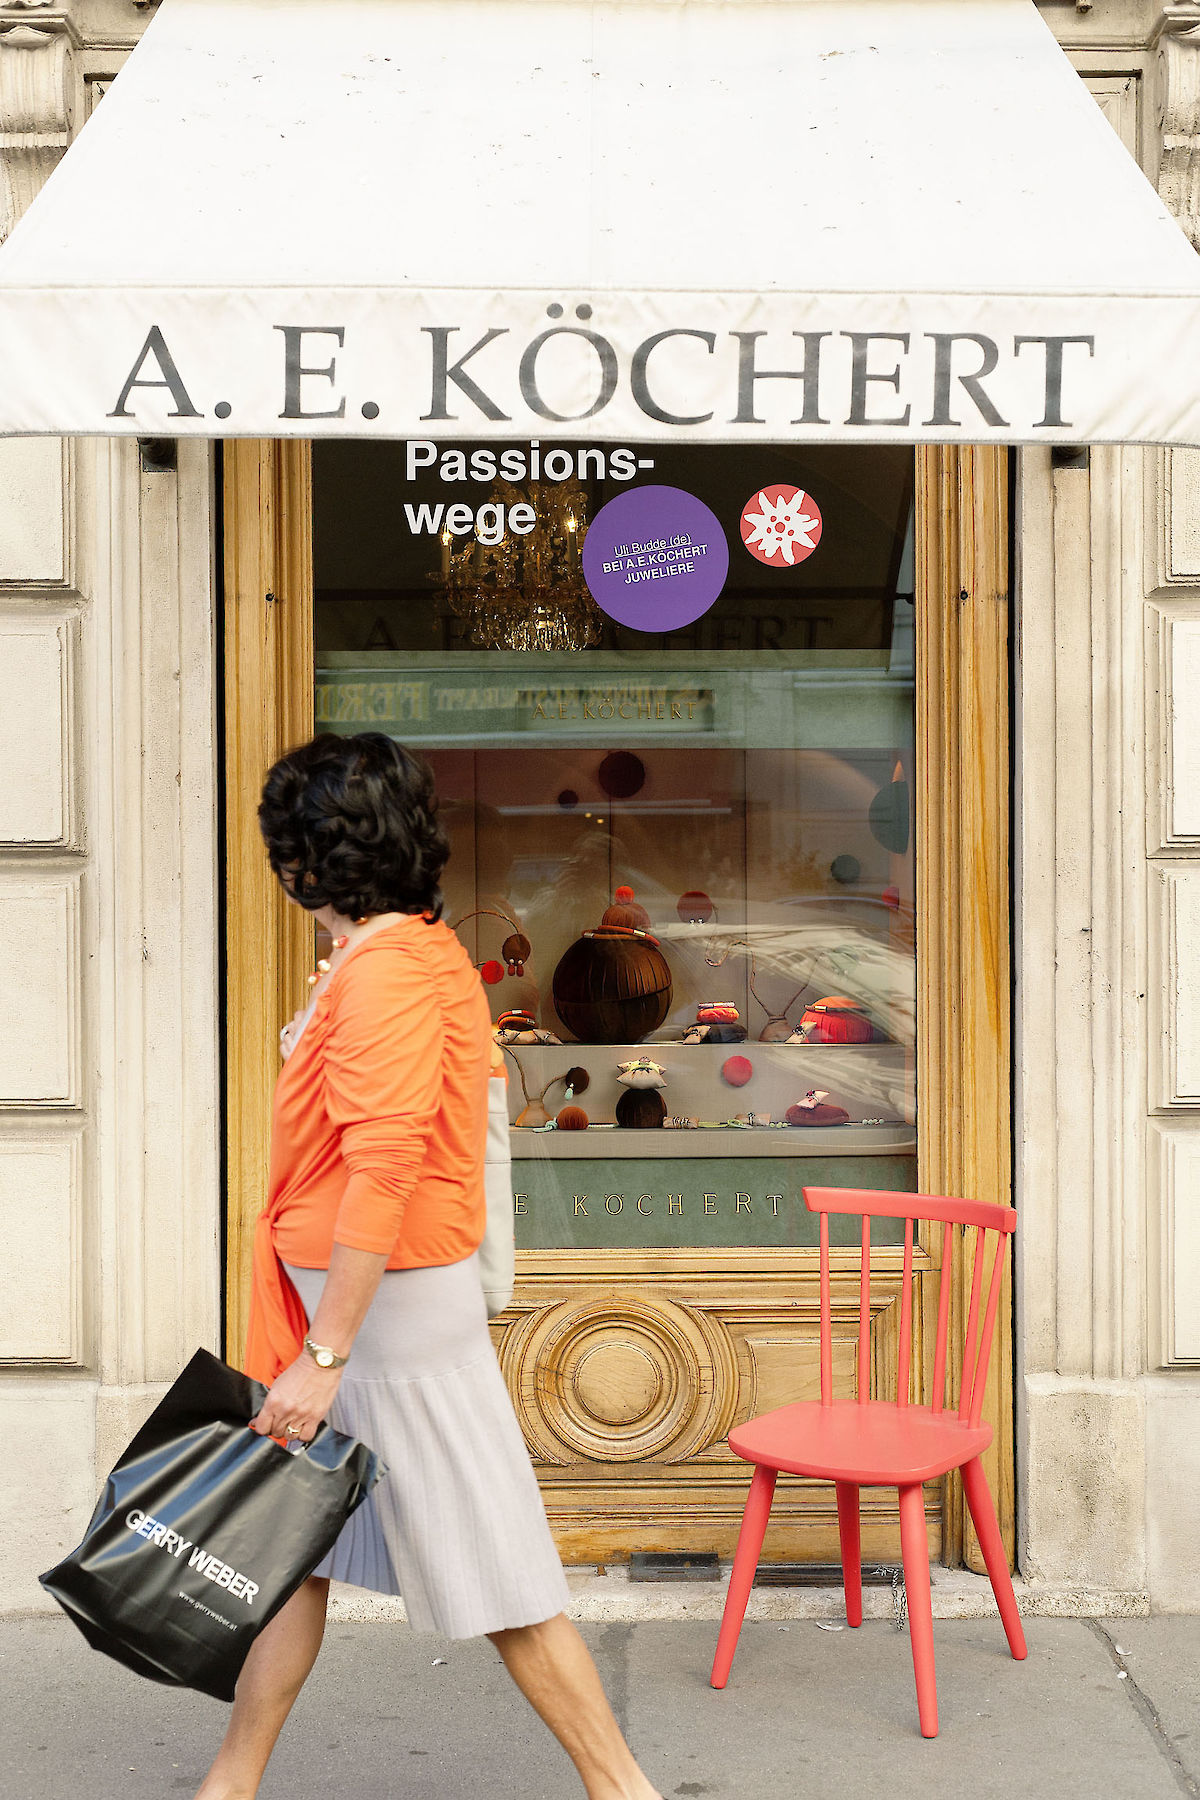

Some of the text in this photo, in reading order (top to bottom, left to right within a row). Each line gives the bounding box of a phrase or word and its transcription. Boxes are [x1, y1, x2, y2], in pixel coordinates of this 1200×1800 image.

[106, 302, 1095, 428] A. E. KÖCHERT
[405, 440, 656, 482] Passions-
[403, 502, 537, 545] wege
[614, 533, 693, 558] Uli Budde (de)
[602, 560, 624, 574] BEI
[624, 562, 695, 584] JUWELIERE
[583, 698, 697, 720] KÖCHERT
[514, 1192, 784, 1216] E KÖCHERT
[125, 1509, 260, 1605] GERRY WEBER
[178, 1591, 238, 1631] www.gerryweber.at
